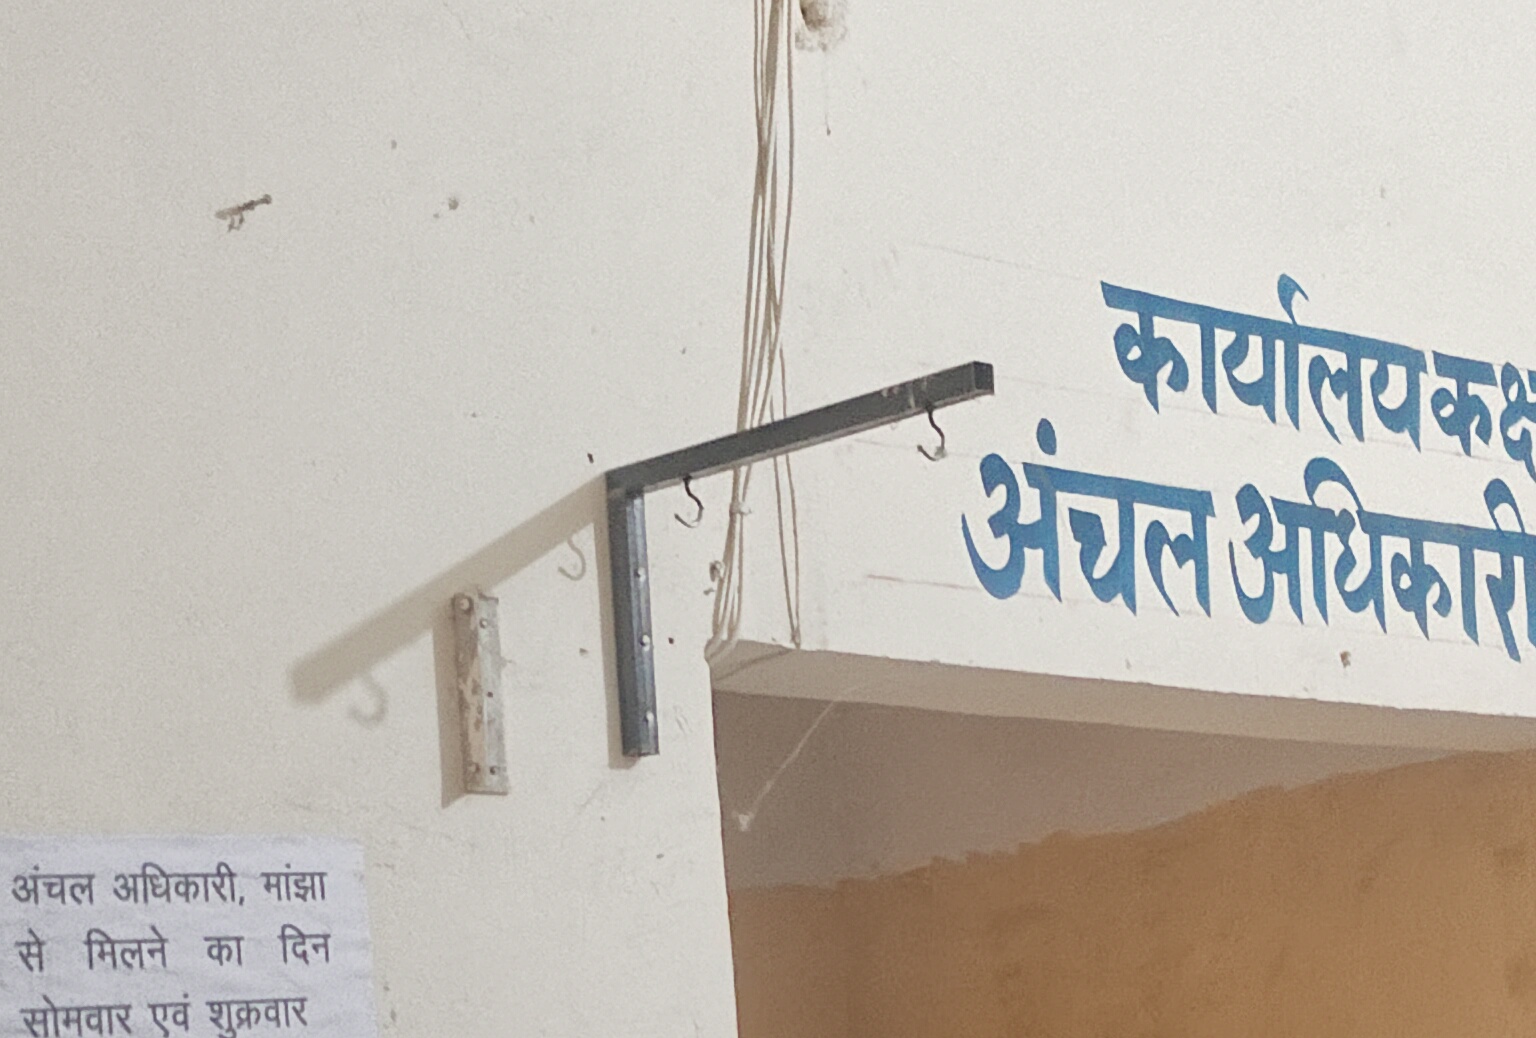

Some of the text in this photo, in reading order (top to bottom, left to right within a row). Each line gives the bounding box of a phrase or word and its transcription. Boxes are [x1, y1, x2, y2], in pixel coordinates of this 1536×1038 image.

[1100, 273, 1426, 452] कार्यालय
[962, 418, 1215, 617] अंचल
[11, 862, 327, 906] अंचल अधिकारी, मांझा
[15, 924, 331, 972] से मिलने का दिन
[21, 995, 133, 1038] सोमवार
[148, 993, 189, 1038] एवं
